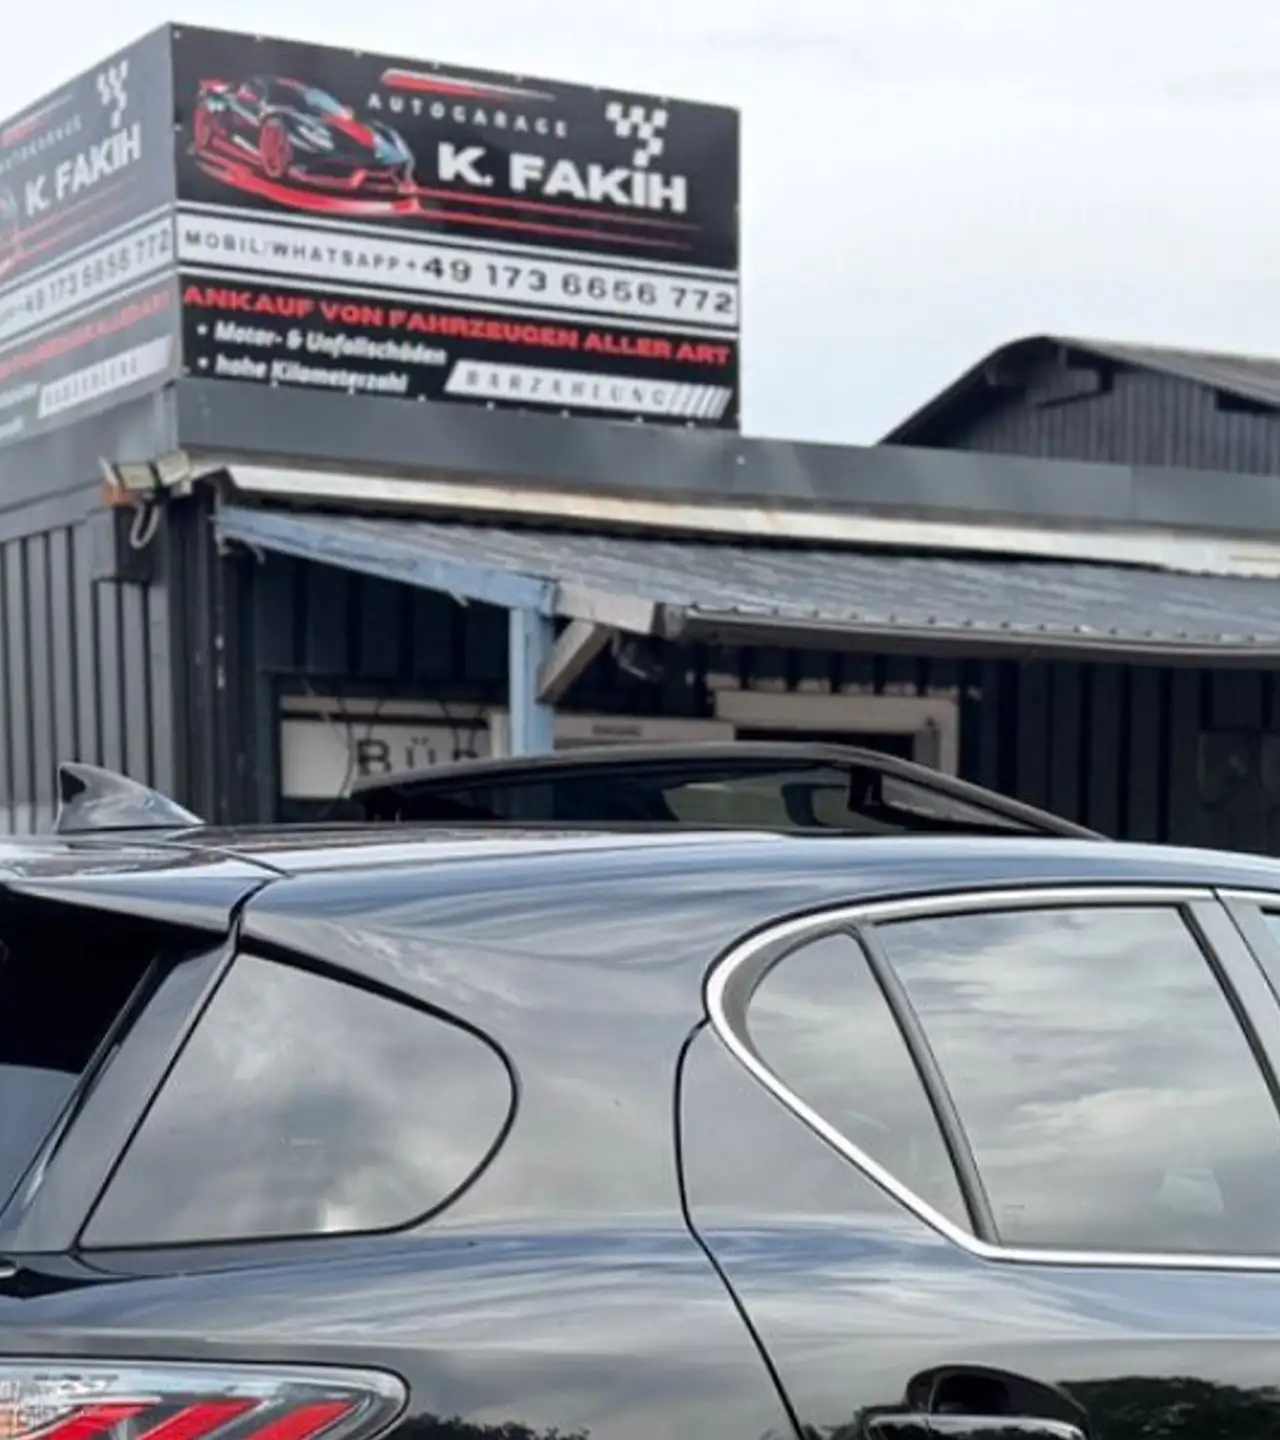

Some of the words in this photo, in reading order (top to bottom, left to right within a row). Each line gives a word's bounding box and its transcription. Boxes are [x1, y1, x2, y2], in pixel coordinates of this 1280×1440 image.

[368, 92, 568, 139] AUTOGARAGE
[437, 142, 494, 187] K.
[486, 262, 548, 292] 173
[561, 272, 657, 306] 6656
[669, 286, 734, 315] 772
[182, 284, 315, 318] ANKAUF
[321, 301, 383, 328] VON
[387, 308, 578, 348] FAHRZEUGEN
[584, 332, 673, 360] ALLER
[675, 342, 731, 365] ART
